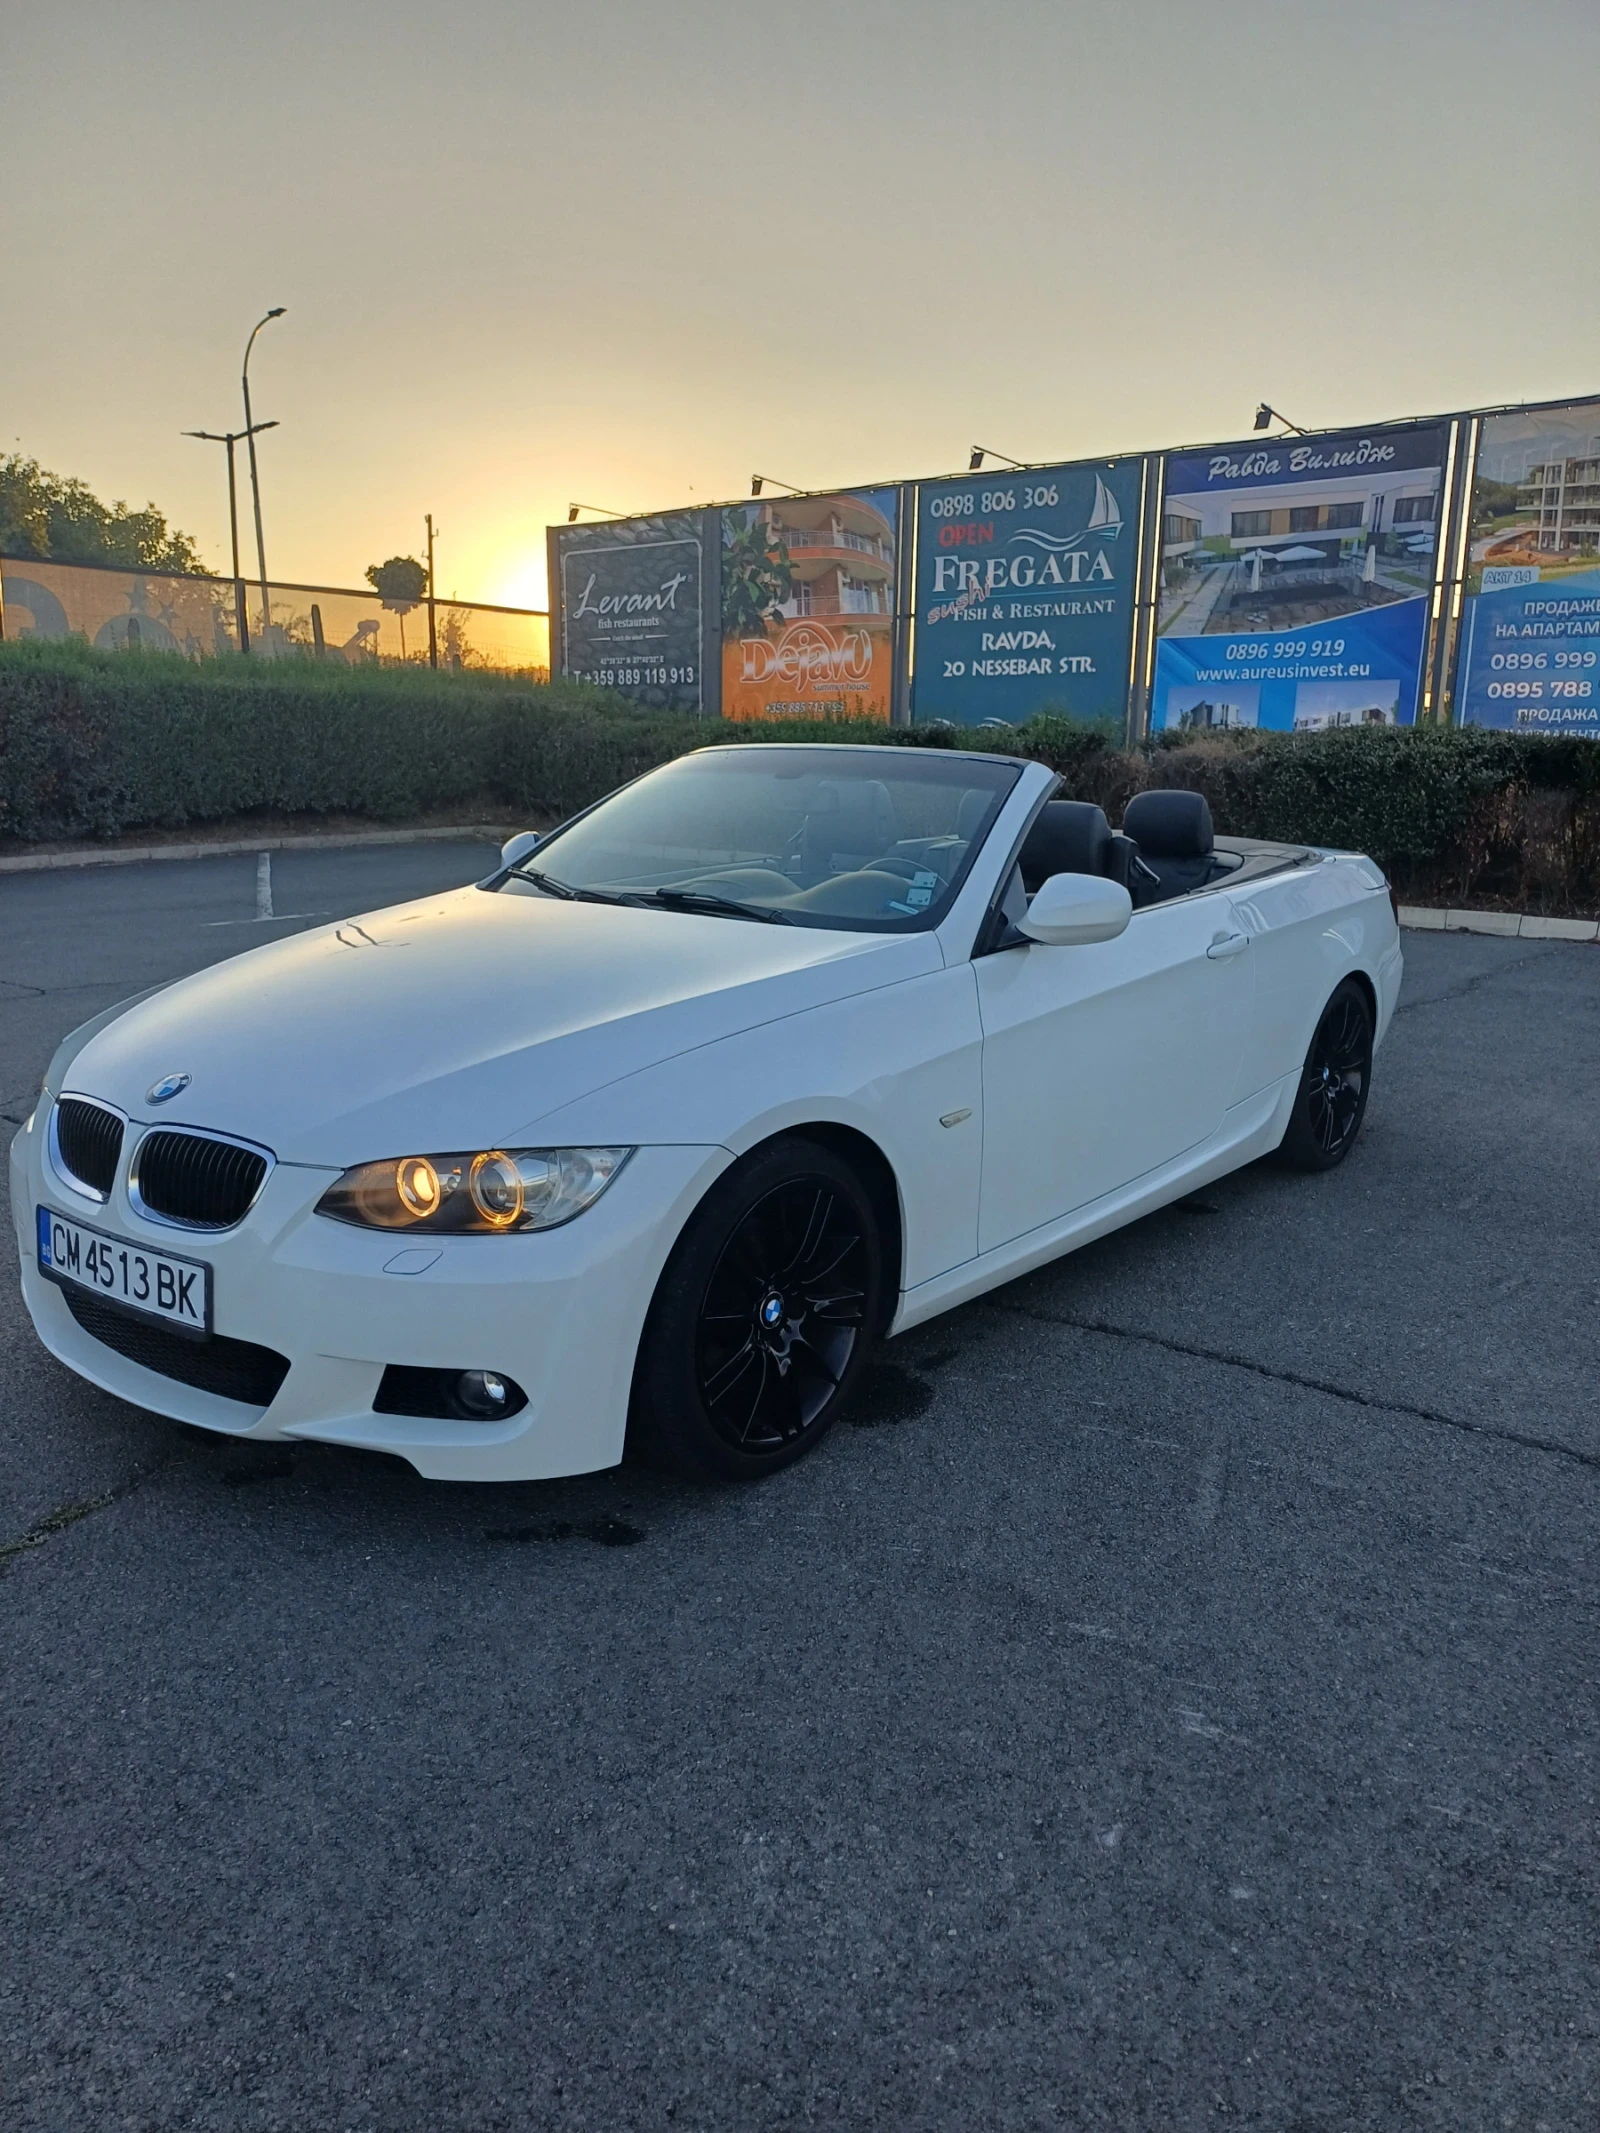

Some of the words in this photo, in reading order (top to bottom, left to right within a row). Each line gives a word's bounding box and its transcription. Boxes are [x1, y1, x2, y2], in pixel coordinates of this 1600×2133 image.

[1207, 452, 1282, 482] Равда
[1288, 439, 1396, 472] Вилидж
[930, 494, 975, 518] 0898
[981, 489, 1016, 513] 806
[1023, 484, 1059, 510] 306
[938, 521, 994, 548] OPEN
[932, 549, 1115, 592] FREGATA
[1513, 570, 1532, 584] 14
[572, 572, 687, 619] Levant
[992, 604, 1004, 620] &
[1010, 599, 1116, 619] RESTAURANT
[598, 618, 613, 629] fish
[614, 616, 660, 628] restaurants
[1495, 624, 1518, 637] НА
[981, 629, 1057, 651] RAVDA,
[1225, 642, 1269, 661] 0896
[1272, 641, 1307, 659] 999
[1310, 639, 1345, 657] 919
[943, 661, 966, 677] 20
[972, 657, 1053, 677] NESSEBAR
[1059, 656, 1097, 674] STR.
[1490, 652, 1548, 671] 0896
[1554, 651, 1597, 669] 999
[585, 669, 614, 686] +359
[618, 668, 641, 685] 889
[644, 667, 667, 684] 119
[670, 666, 694, 684] 913
[1196, 662, 1370, 682] www.aureusinvest.eu
[1487, 682, 1543, 699] 0895
[1550, 681, 1592, 698] 788
[1517, 708, 1598, 723] ПРОДАЖА
